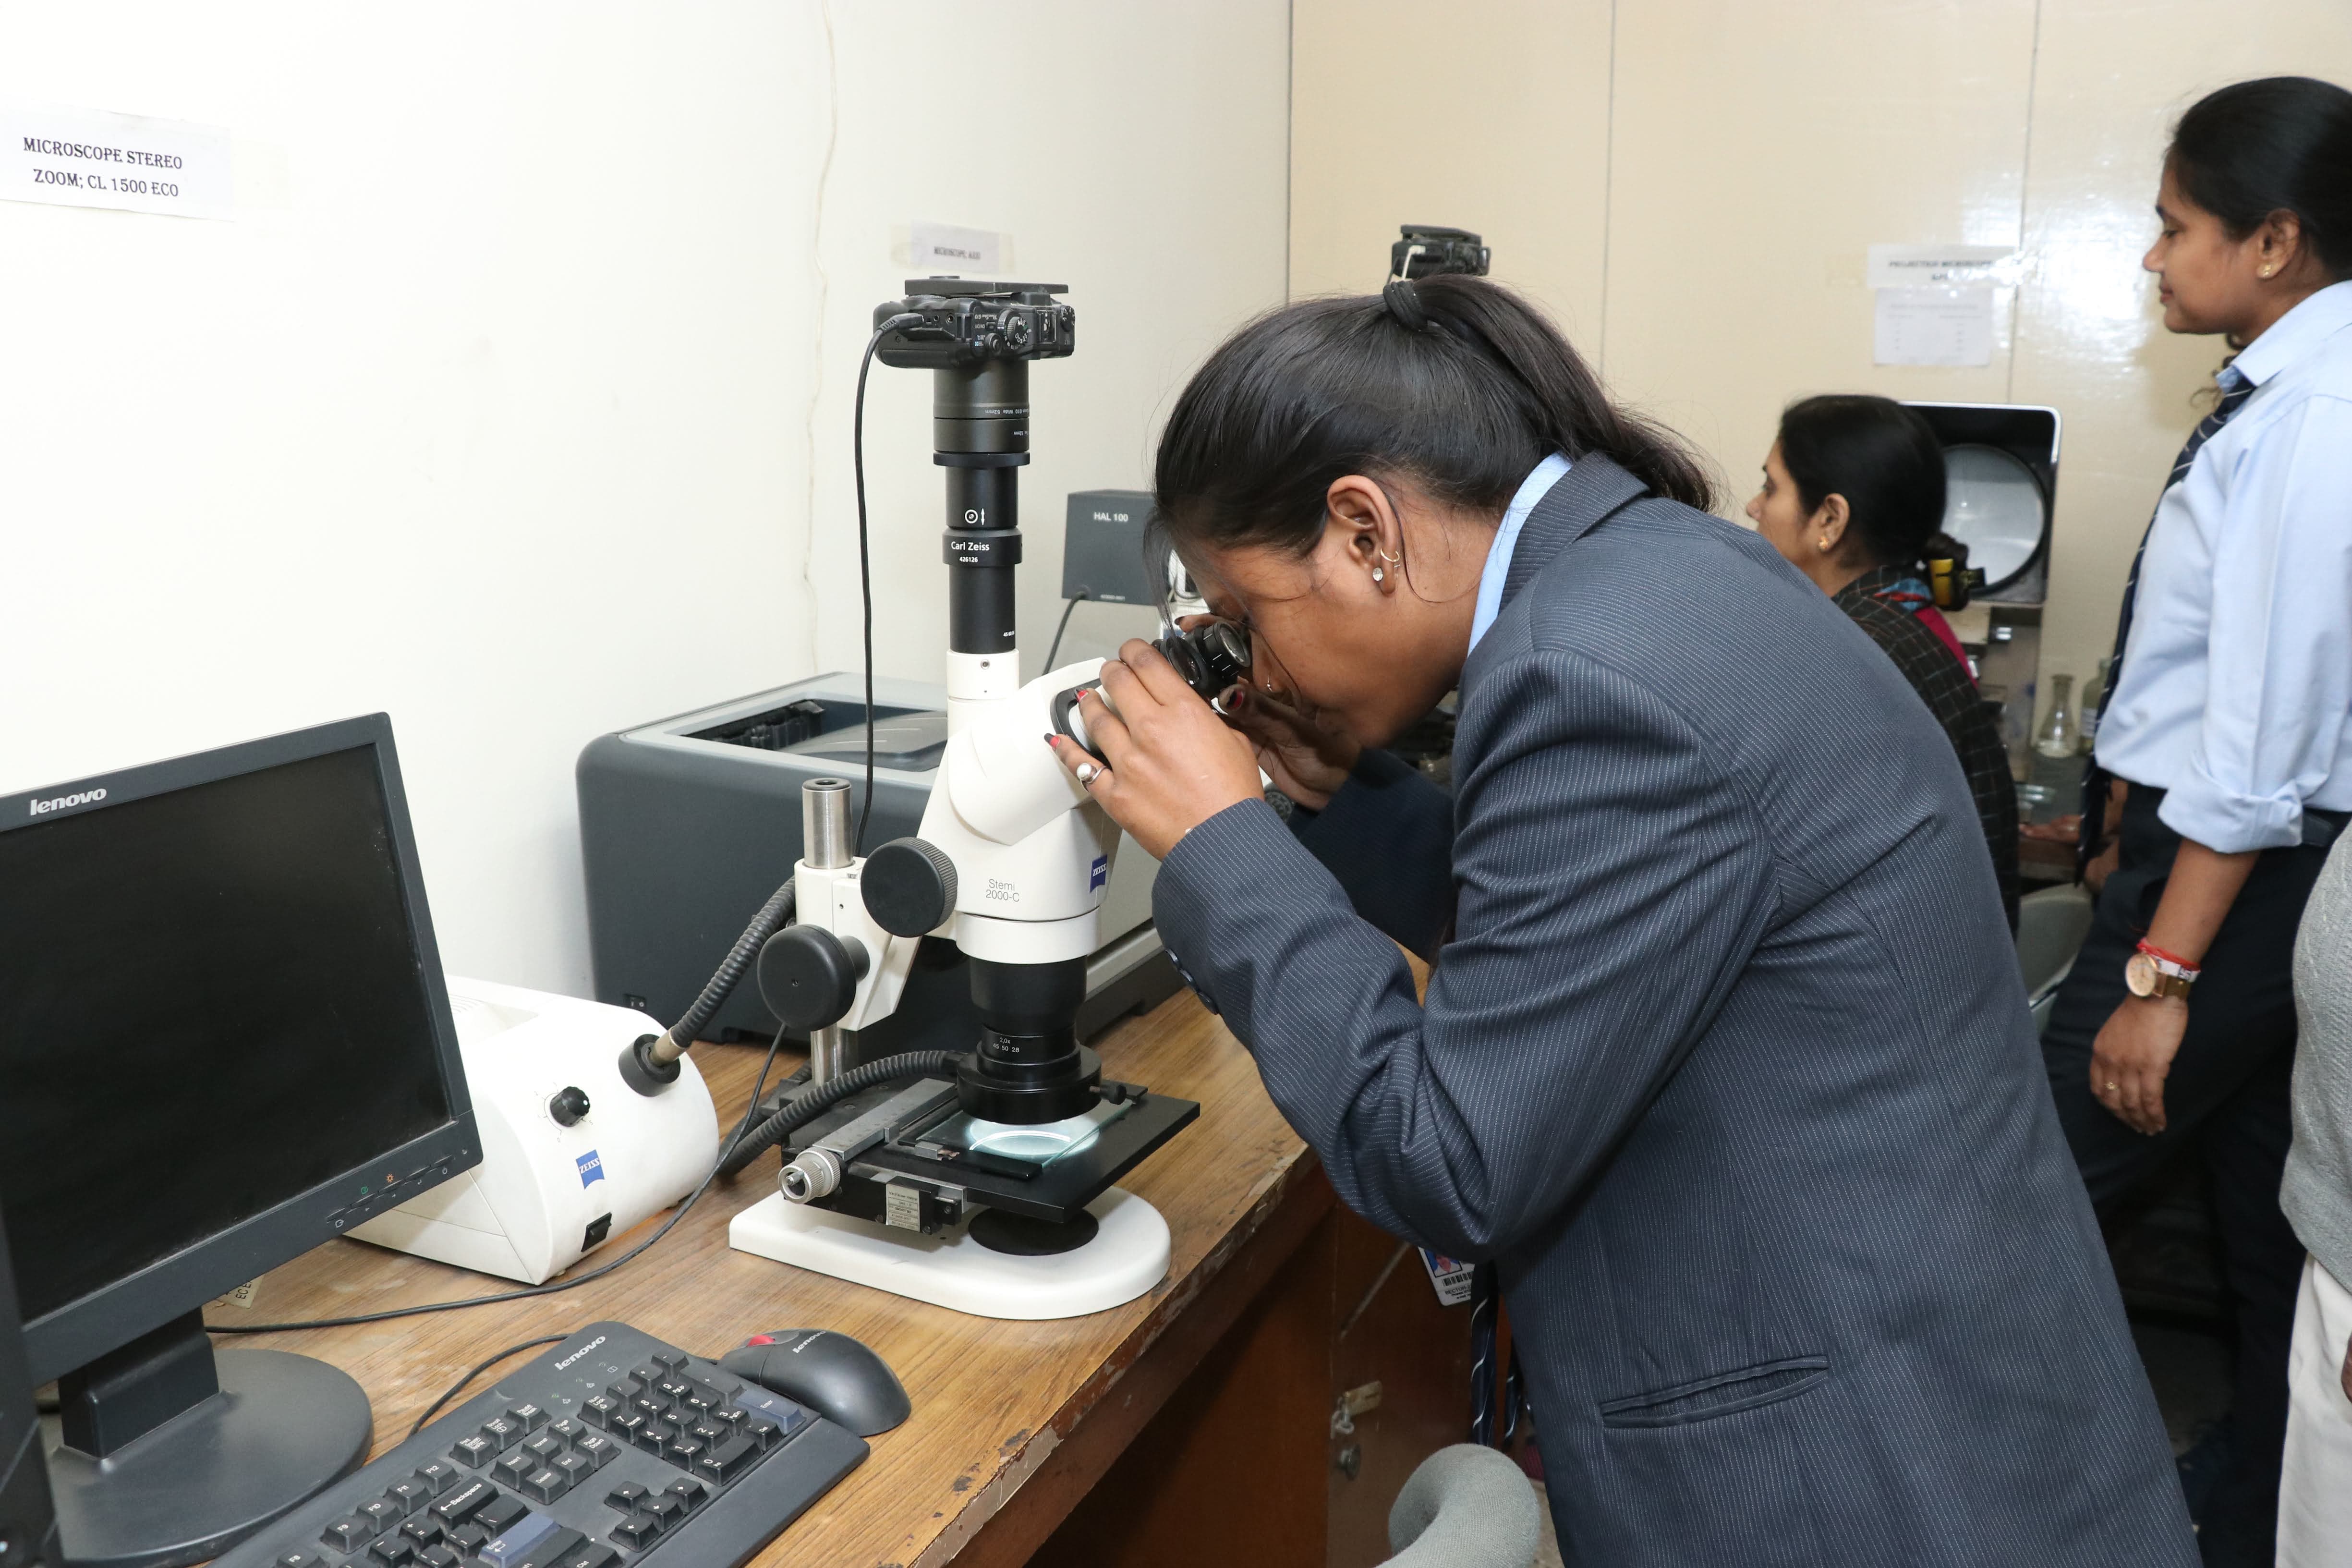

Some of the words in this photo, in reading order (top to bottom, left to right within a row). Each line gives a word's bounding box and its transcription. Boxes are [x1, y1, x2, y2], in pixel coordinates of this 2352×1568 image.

[23, 137, 123, 162] MICROSCOPE
[127, 150, 182, 169] STEREO
[33, 169, 84, 189] ZOOM;
[87, 175, 107, 190] CL
[111, 178, 147, 194] 1500
[151, 182, 179, 197] ECO
[1094, 511, 1112, 521] HAL
[1114, 513, 1129, 522] 100
[951, 541, 966, 550] Carl
[968, 542, 990, 551] Zeiss
[30, 788, 107, 816] lenovo
[1092, 863, 1107, 877] ZEISS
[989, 878, 1015, 891] Stemi
[986, 889, 1019, 902] 2000-C
[579, 1157, 600, 1174] ZEISS
[792, 1331, 826, 1353] lenovo
[554, 1336, 606, 1370] lenovo
[555, 1419, 569, 1429] Page
[626, 1416, 641, 1426] Home
[533, 1437, 548, 1449] Home
[583, 1437, 597, 1446] Page
[589, 1438, 605, 1449] Down
[506, 1456, 522, 1466] Insert
[561, 1457, 573, 1466] End
[426, 1465, 440, 1473] F12
[535, 1472, 552, 1484] Delete
[397, 1484, 409, 1493] F11
[450, 1483, 482, 1506] Backspace
[368, 1503, 382, 1512] F10
[486, 1540, 503, 1550] Enter
[289, 1555, 301, 1563] F8
